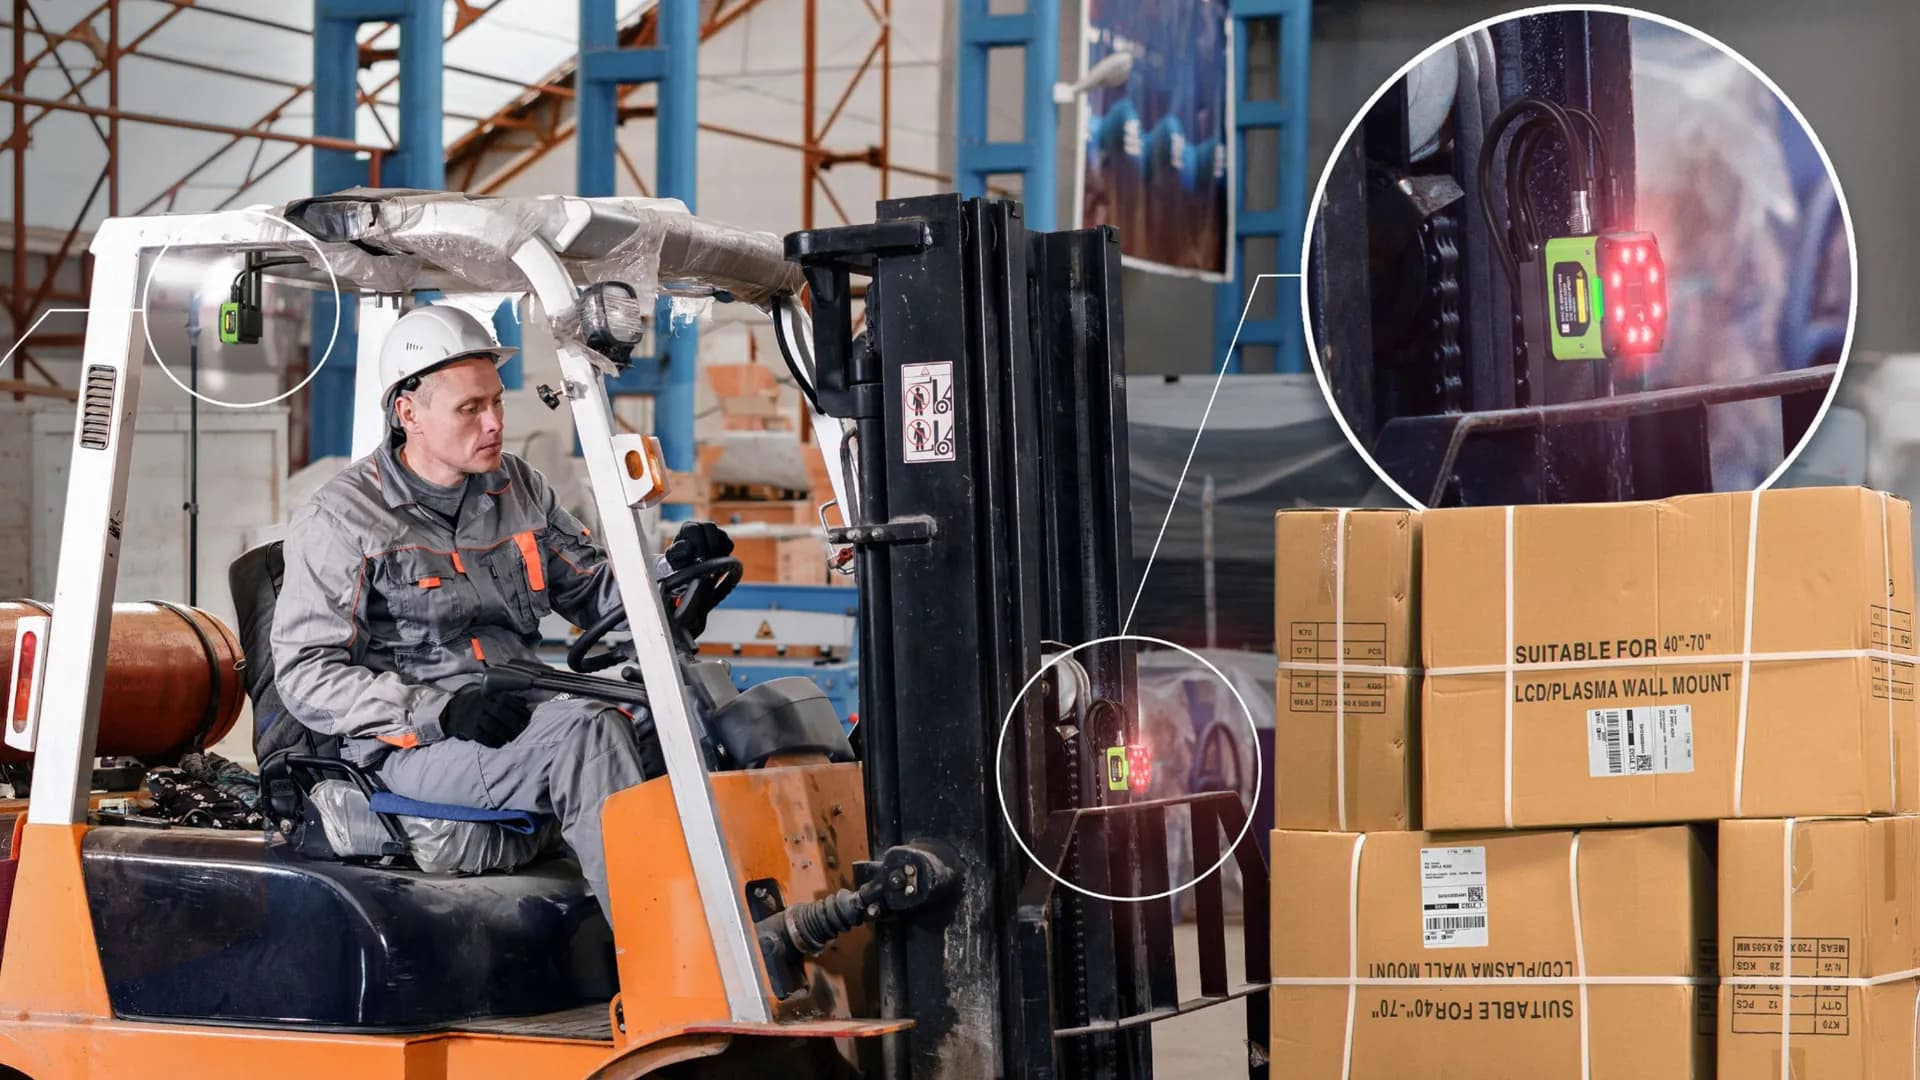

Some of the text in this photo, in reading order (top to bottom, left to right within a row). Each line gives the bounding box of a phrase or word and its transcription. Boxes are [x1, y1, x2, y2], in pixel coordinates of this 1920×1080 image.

[1515, 634, 1712, 664] SUITABLE FOR 40"-70"
[1515, 673, 1732, 702] LCD/PLASMA WALL MOUNT
[1797, 943, 1812, 953] 720
[1820, 943, 1846, 953] MEAS
[1368, 961, 1573, 978] LCD/PLASMA WALL MOUNT
[1736, 961, 1757, 971] KGS
[1478, 999, 1574, 1020] SUITABLE
[1736, 1000, 1842, 1011] Q'TY 12 PCS
[1822, 1020, 1840, 1029] K70
